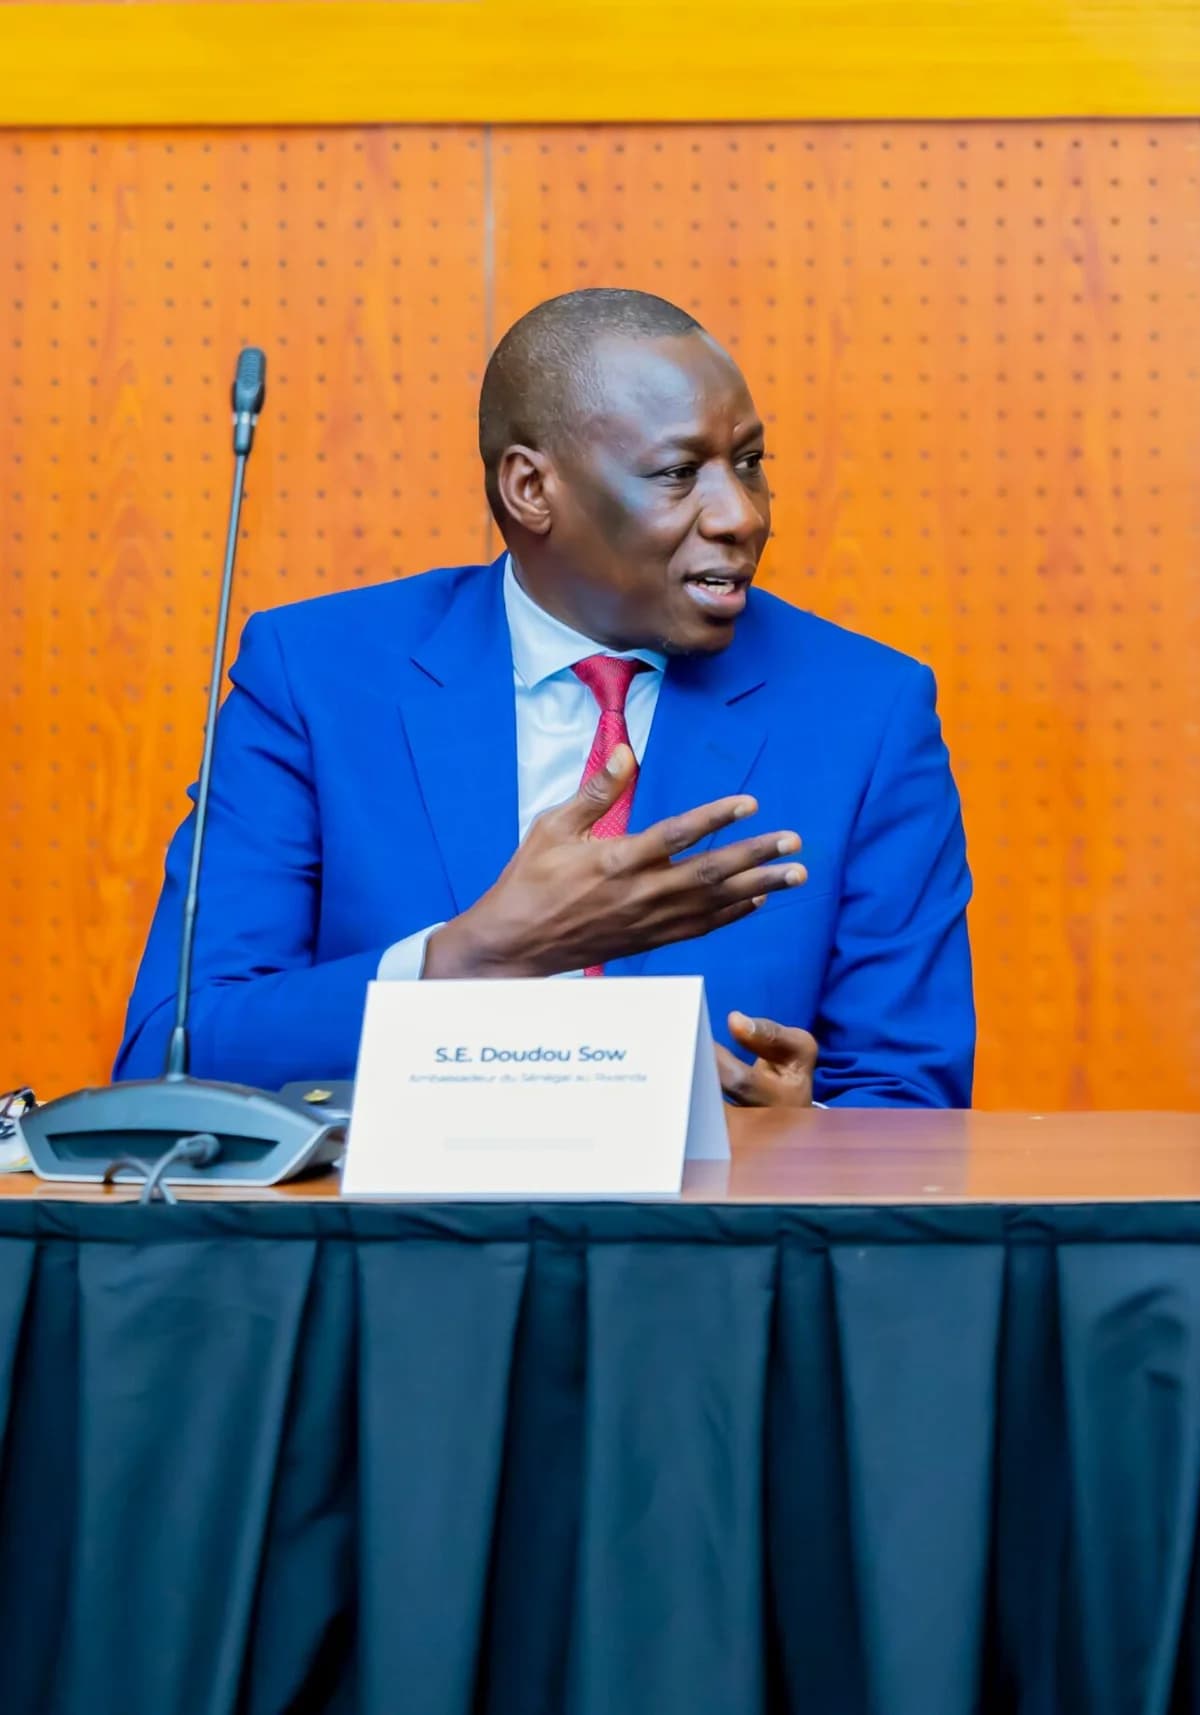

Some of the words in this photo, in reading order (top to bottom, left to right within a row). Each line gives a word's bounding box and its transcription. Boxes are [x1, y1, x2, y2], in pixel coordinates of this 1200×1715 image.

[434, 1047, 473, 1062] S.E.
[481, 1046, 571, 1062] Doudou
[578, 1045, 627, 1062] Sow
